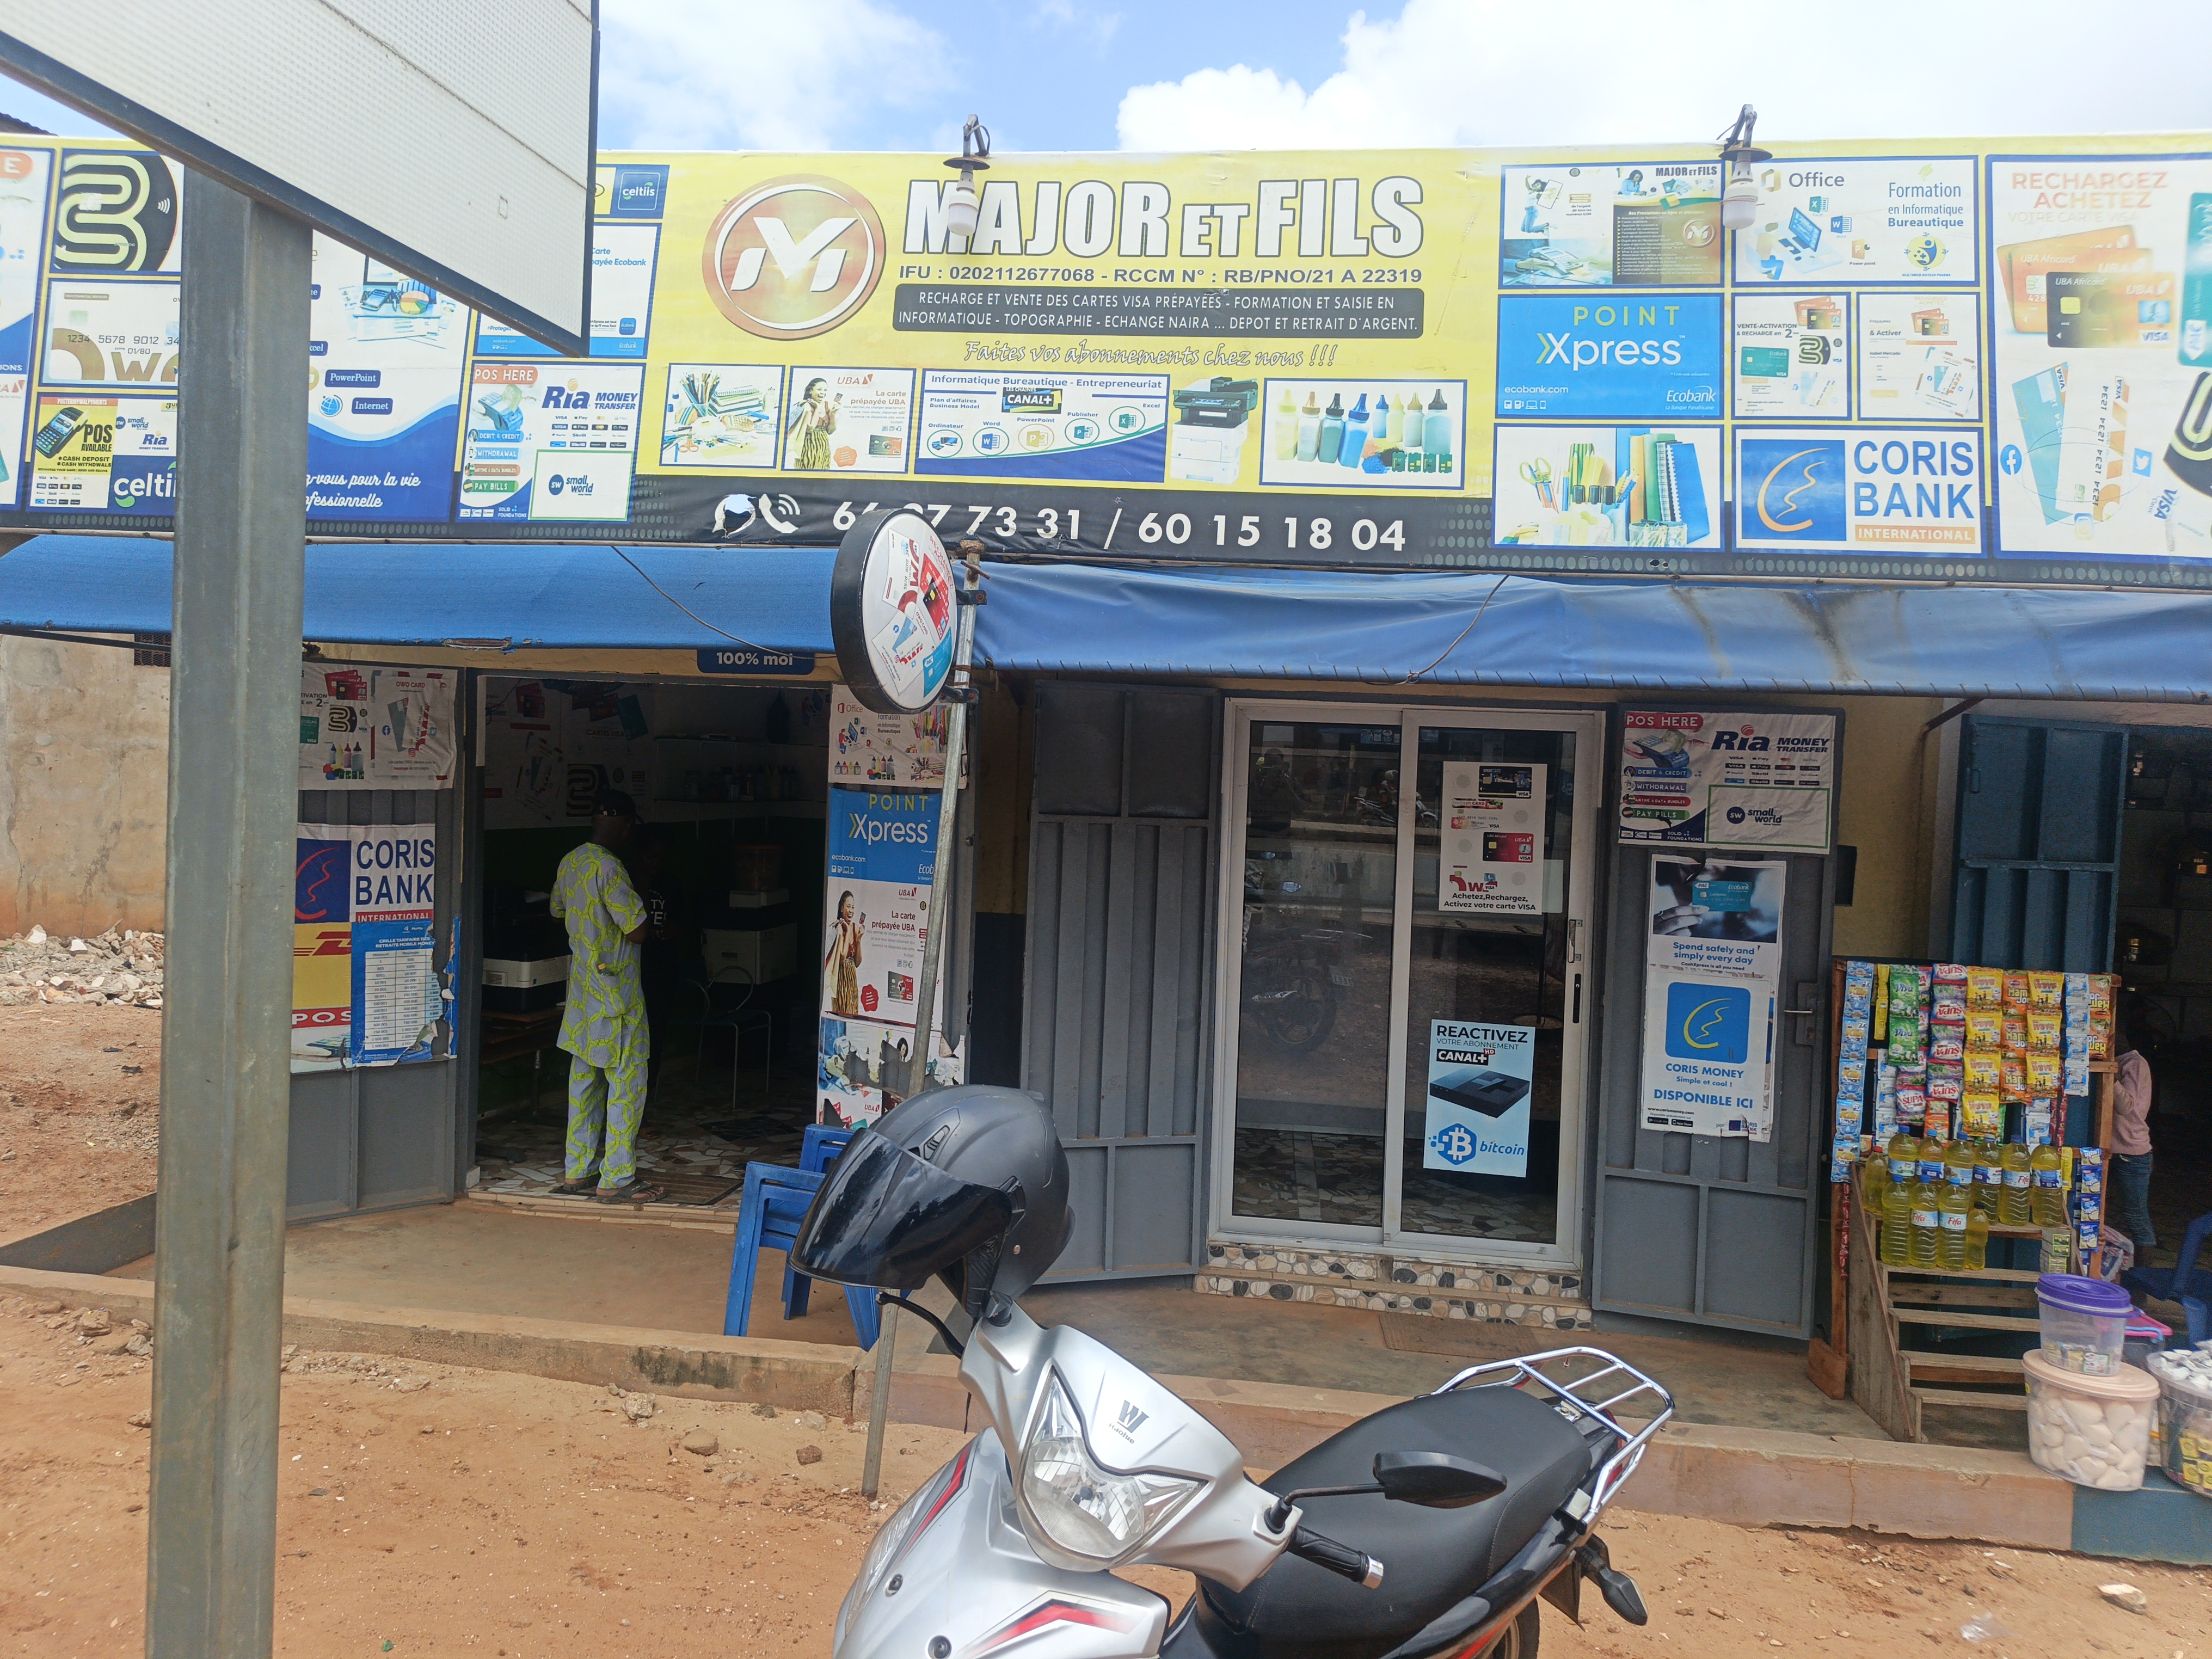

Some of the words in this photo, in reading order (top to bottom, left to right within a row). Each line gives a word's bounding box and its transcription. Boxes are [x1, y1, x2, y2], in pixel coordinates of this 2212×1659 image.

[1656, 168, 1688, 176] MAJOR
[1698, 166, 1717, 176] FILS
[1789, 172, 1845, 187] Office
[2012, 171, 2168, 190] RECHARGEZ
[623, 187, 655, 196] celtiis
[1889, 182, 1961, 198] Formation
[2033, 192, 2152, 208] ACHETEZ
[902, 179, 1171, 259] MAJOR
[1180, 204, 1250, 257] ET
[1255, 176, 1424, 259] FILS
[1888, 206, 1900, 214] en
[1902, 204, 1963, 217] Informatique
[1888, 218, 1963, 228] Bureautique
[900, 266, 931, 279] IFU
[949, 267, 1095, 282] 0202112677068
[1114, 269, 1175, 282] RCCM
[1182, 269, 1205, 282] N°
[1224, 269, 1334, 283] RB/PNO/21
[1341, 269, 1356, 282] A
[1362, 269, 1422, 282] 22319
[919, 292, 982, 305] RECHARGE
[987, 293, 1000, 305] ET
[1005, 293, 1042, 306] VENTE
[1046, 294, 1068, 307] DES
[1072, 294, 1118, 308] CARTES
[1123, 295, 1150, 308] VISA
[1234, 297, 1311, 309] FORMATION
[1317, 297, 1331, 309] ET
[1335, 297, 1372, 309] SAISIE
[1377, 297, 1393, 309] EN
[899, 311, 991, 325] INFORMATIQUE
[1004, 314, 1092, 327] TOPOGRAPHIE
[1105, 316, 1164, 329] ECHANGE
[1169, 316, 1209, 329] NAIRA
[1230, 317, 1270, 330] DEPOT
[1275, 317, 1289, 330] ET
[1293, 317, 1344, 330] RETRAIT
[1574, 306, 1680, 326] POINT
[68, 334, 90, 343] 1234
[99, 335, 125, 344] 5678
[133, 336, 159, 345] 9012
[2142, 333, 2169, 341] VISA
[965, 341, 1025, 362] Faites
[1031, 348, 1060, 362] vos
[1065, 339, 1199, 365] abonnements
[1204, 343, 1250, 366] chez
[1255, 350, 1303, 367] nous
[1545, 333, 1681, 371] Xpress
[330, 373, 377, 382] PowerPoint
[475, 369, 497, 380] POS
[503, 370, 534, 381] HERE
[837, 377, 860, 385] UBA
[932, 376, 1000, 386] Informatique
[1003, 377, 1067, 387] Bureautique
[1076, 379, 1162, 390] Entrepreneuriat
[542, 378, 591, 409] Ria
[596, 392, 638, 402] MONEY
[1007, 395, 1052, 405] CANAL+
[1666, 385, 1716, 402] Ecobank
[355, 402, 389, 410] Internet
[851, 398, 887, 406] prépayée
[83, 425, 113, 443] POS
[1854, 440, 1974, 476] CORIS
[348, 473, 382, 489] pour
[400, 472, 421, 487] vie
[1854, 482, 1975, 519] BANK
[968, 506, 1017, 537] 73
[1036, 508, 1079, 539] 31
[1139, 512, 1191, 544] 60
[1213, 514, 1260, 547] 15
[1285, 517, 1332, 549] 18
[1351, 519, 1405, 551] 04
[1858, 528, 1971, 541] INTERNATIONAL
[717, 652, 759, 666] 100%
[764, 653, 793, 666] moi
[1627, 716, 1654, 726] POS
[1662, 717, 1698, 727] HERE
[1711, 724, 1771, 752] Ria
[1777, 738, 1830, 746] MONEY
[1637, 783, 1685, 791] WITHDRAWAL
[869, 794, 928, 812] POINT
[854, 813, 928, 845] Xpress
[357, 839, 435, 870] CORIS
[832, 855, 865, 863] ecobank.com
[356, 874, 434, 906] BANK
[899, 889, 911, 897] UBA
[872, 920, 900, 931] prépayée
[902, 923, 915, 931] UBA
[1673, 942, 1703, 953] Spend
[1705, 943, 1734, 955] safely
[1736, 945, 1755, 955] and
[1674, 951, 1704, 962] simply
[1706, 954, 1732, 964] every
[1735, 955, 1753, 965] day
[1436, 1025, 1528, 1043] REACTIVEZ
[1463, 1040, 1519, 1050] ABONNEMENT
[1438, 1050, 1487, 1063] CANAL+
[1666, 1062, 1699, 1074] CORIS
[1702, 1066, 1744, 1079] MONEY
[1676, 1076, 1701, 1085] Simple
[1712, 1078, 1728, 1086] cool
[1654, 1089, 1732, 1107] DISPONIBLE
[1737, 1096, 1753, 1109] ICI
[1902, 1095, 1924, 1105] SUPA
[1480, 1140, 1525, 1156] bitcoin
[1948, 1216, 1962, 1226] Fifa
[1109, 1423, 1135, 1444] Haojue
